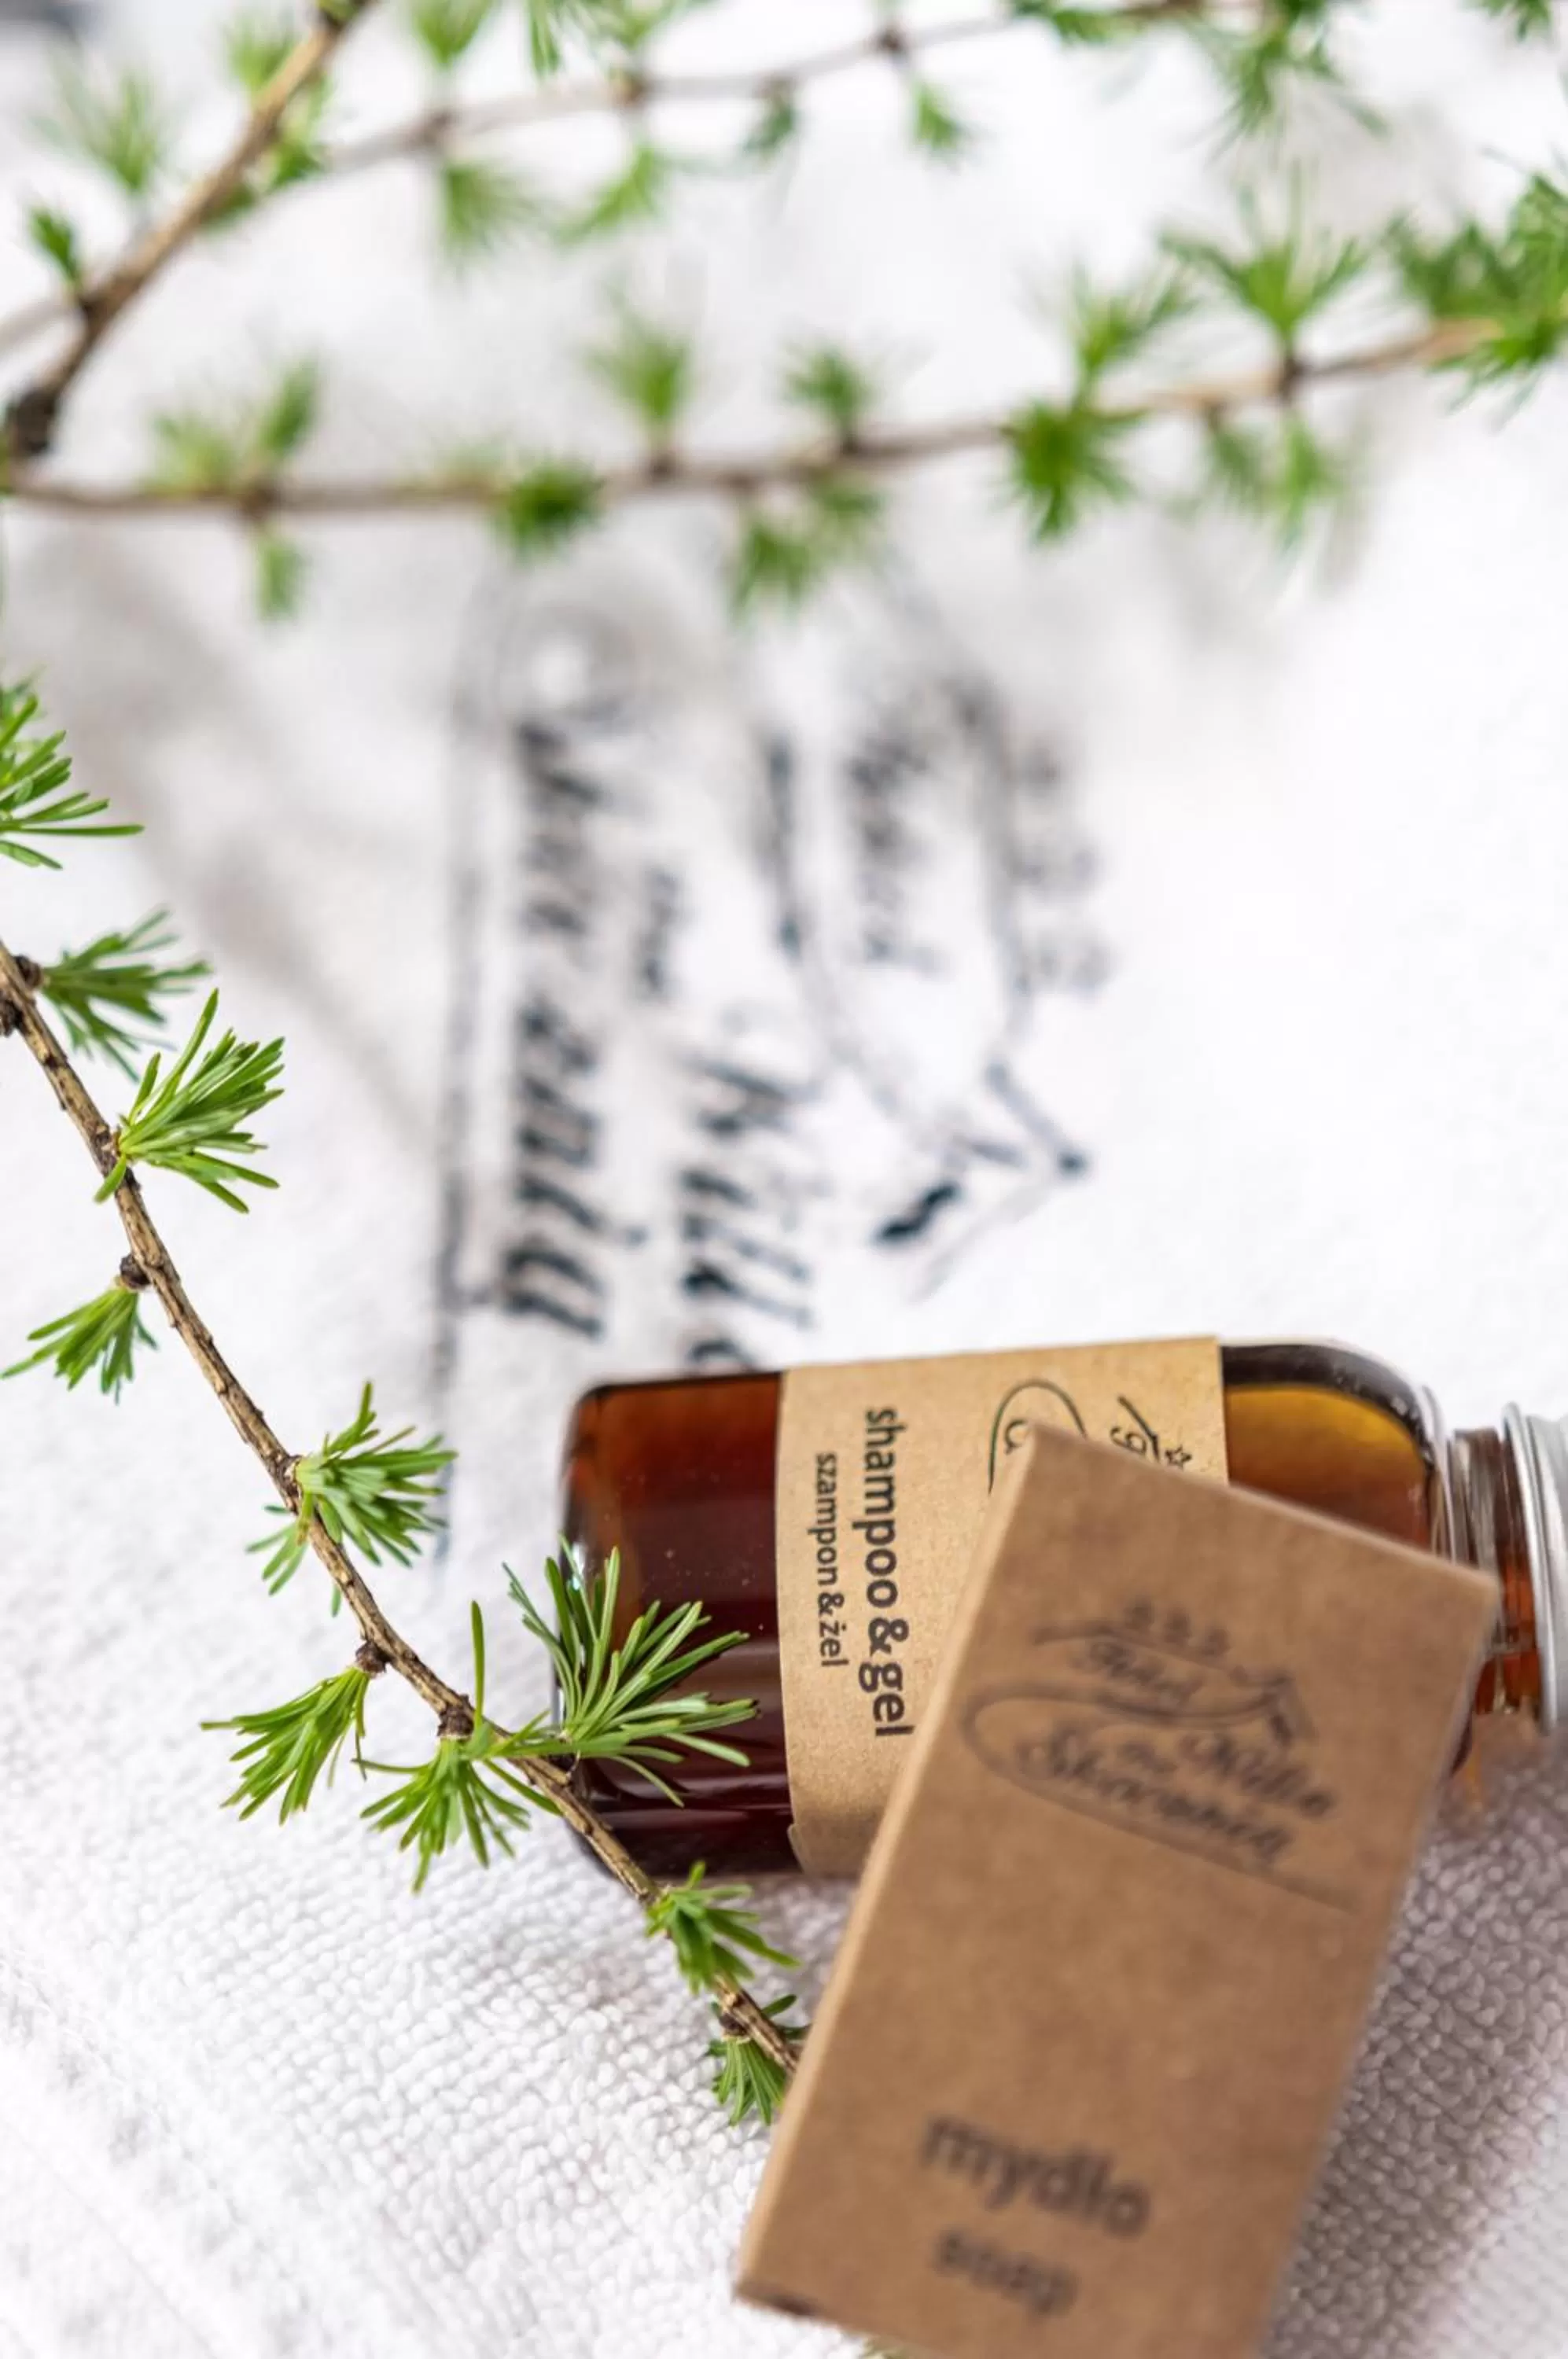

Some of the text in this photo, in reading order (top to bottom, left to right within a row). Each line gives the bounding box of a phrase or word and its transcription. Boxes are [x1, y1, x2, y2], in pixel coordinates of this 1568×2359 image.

[807, 1452, 850, 1668] szampon & żel
[852, 1404, 915, 1737] shampoo & gel
